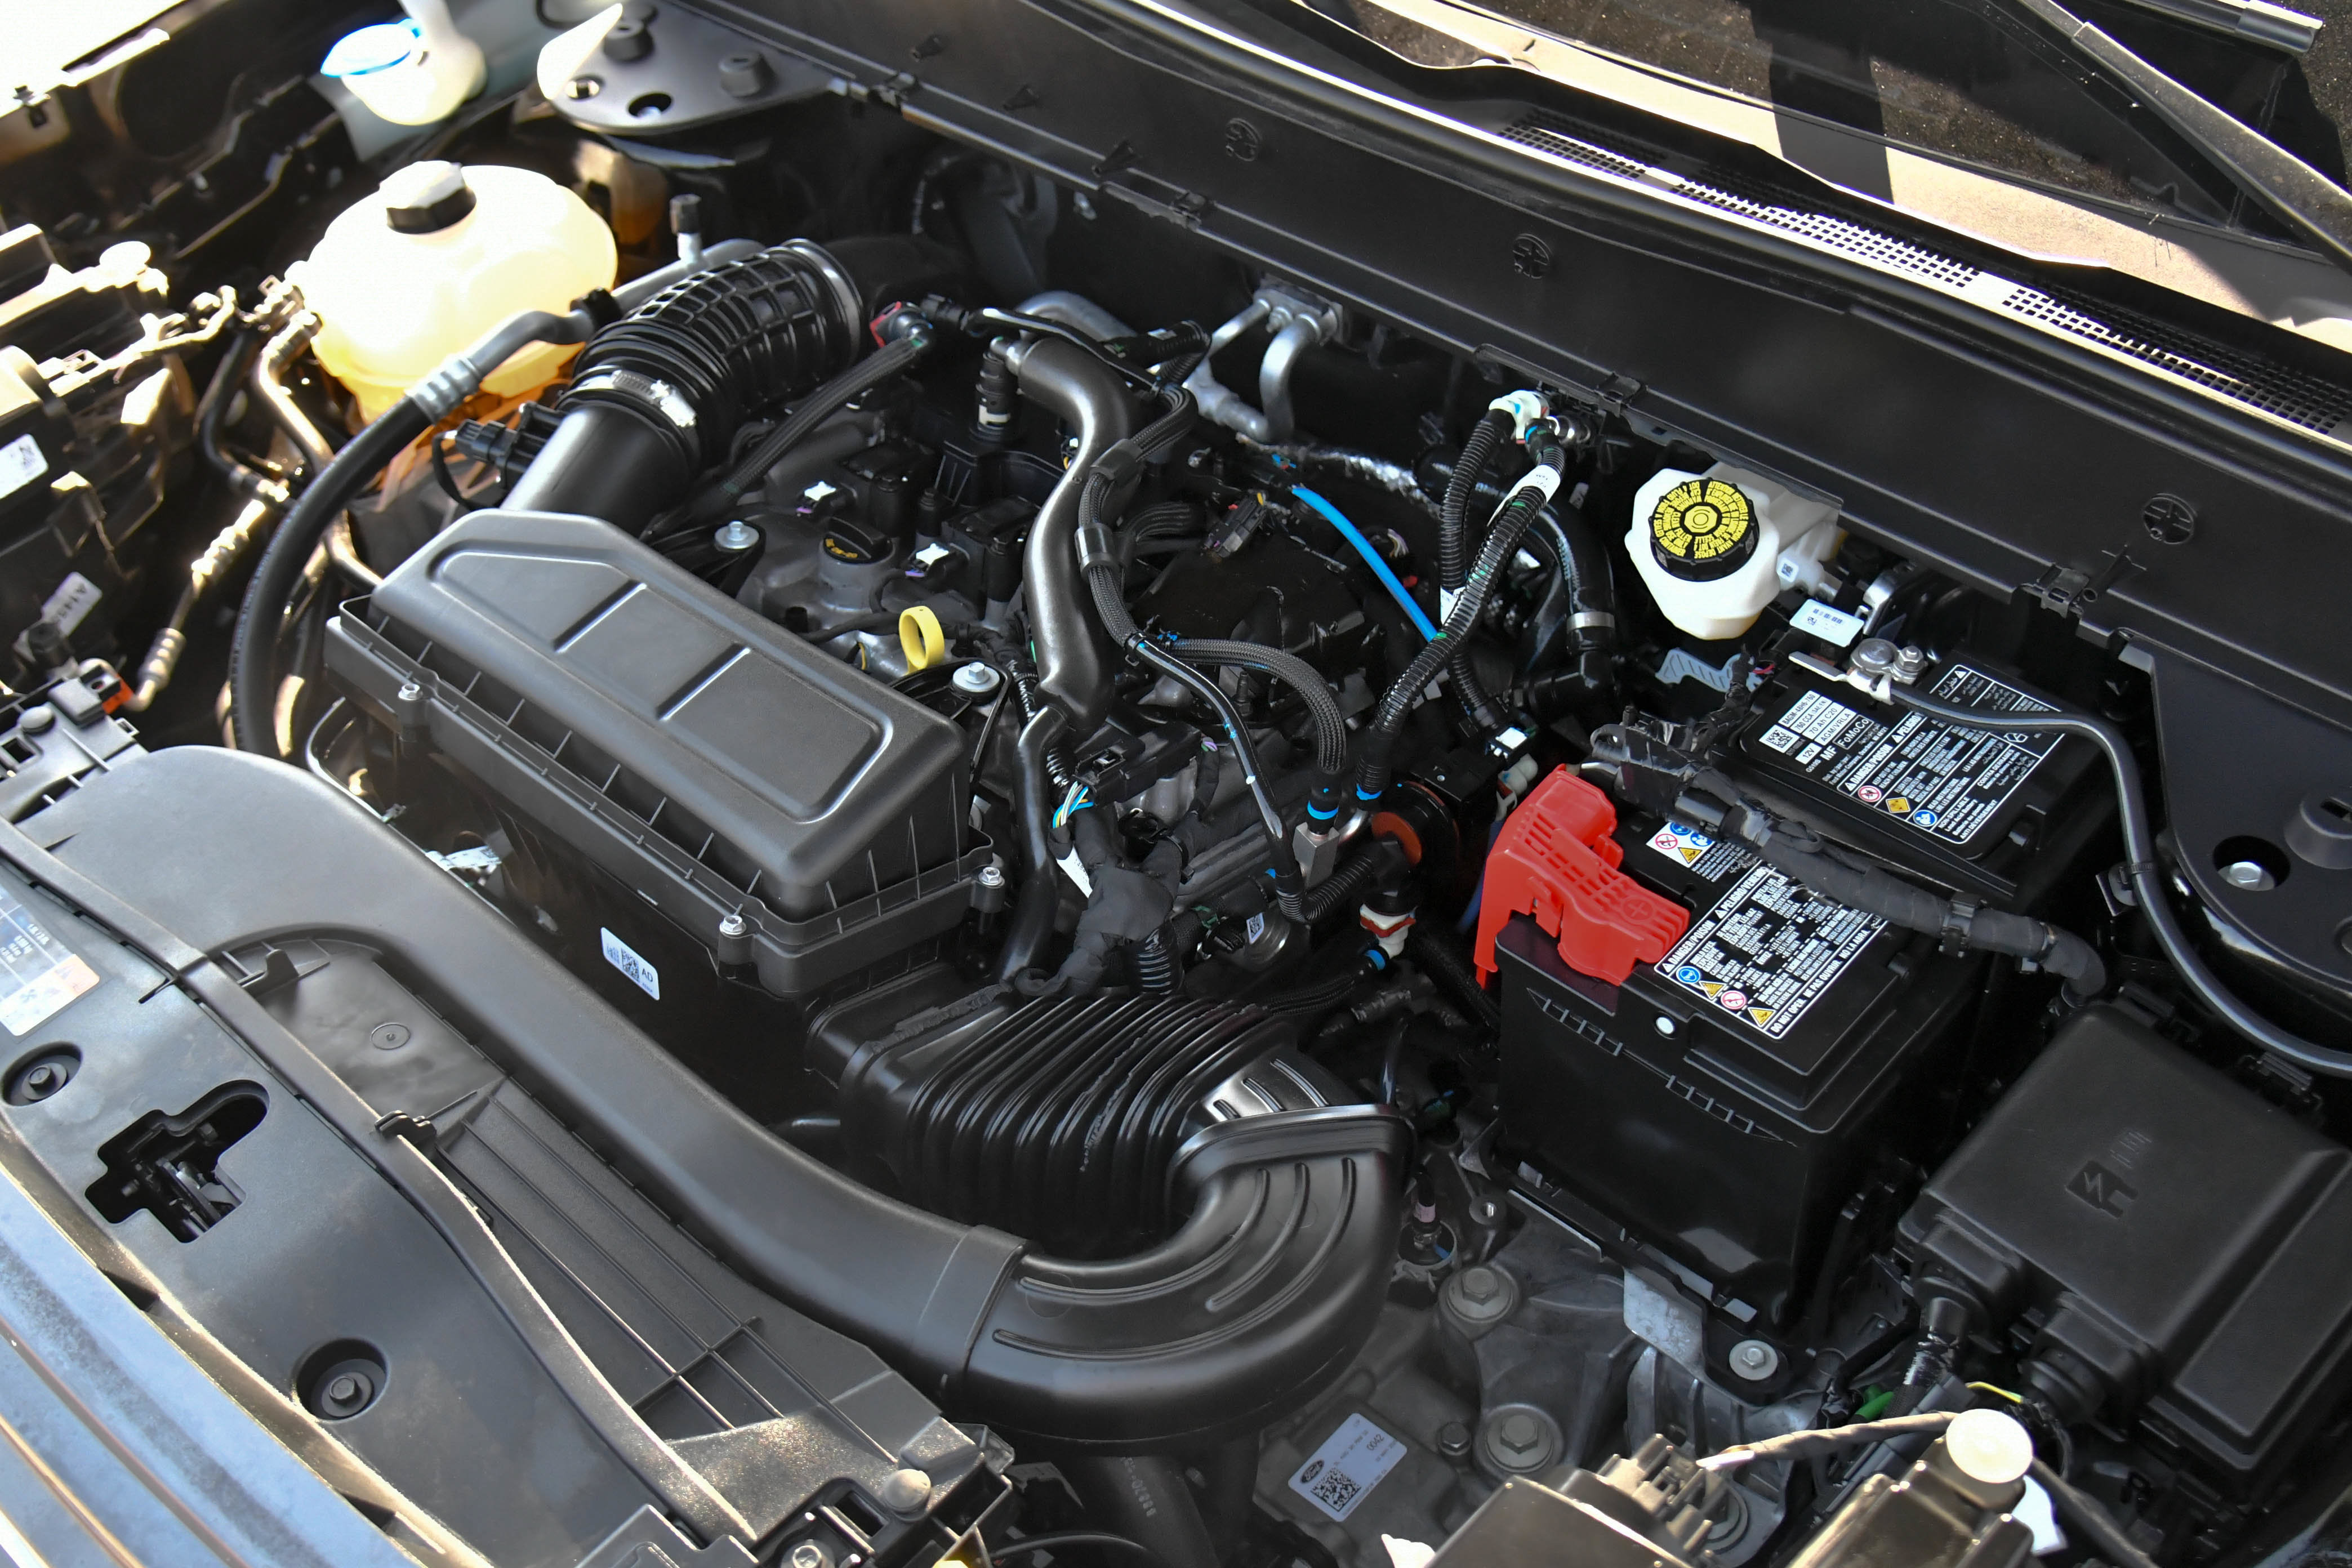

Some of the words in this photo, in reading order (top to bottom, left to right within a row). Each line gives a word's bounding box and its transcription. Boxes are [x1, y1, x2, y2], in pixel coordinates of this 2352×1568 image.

[1802, 713, 1814, 722] CCA
[1816, 719, 1827, 727] Ah
[1824, 707, 1837, 719] C20
[1820, 713, 1850, 741] AGM/VRLA
[1837, 719, 1869, 746] FoMoCo
[1802, 747, 1814, 758] 12V
[1820, 745, 1836, 760] MF
[1850, 744, 1892, 783] DANGER/POISON
[1977, 769, 1994, 786] CONTRA
[1992, 749, 2014, 770] DERRAMES
[1938, 796, 1969, 828] NON-SPILLABLE
[1959, 828, 1971, 839] ANTI
[1668, 920, 1714, 964] DANGER/POISON
[1838, 949, 1851, 959] NO
[1845, 942, 1857, 951] LA
[642, 968, 653, 982] AD
[1803, 988, 1815, 997] NE
[1809, 978, 1824, 990] PAS
[1770, 1022, 1783, 1032] DO
[1778, 1012, 1792, 1024] NOT
[1366, 1433, 1384, 1451] 0042
